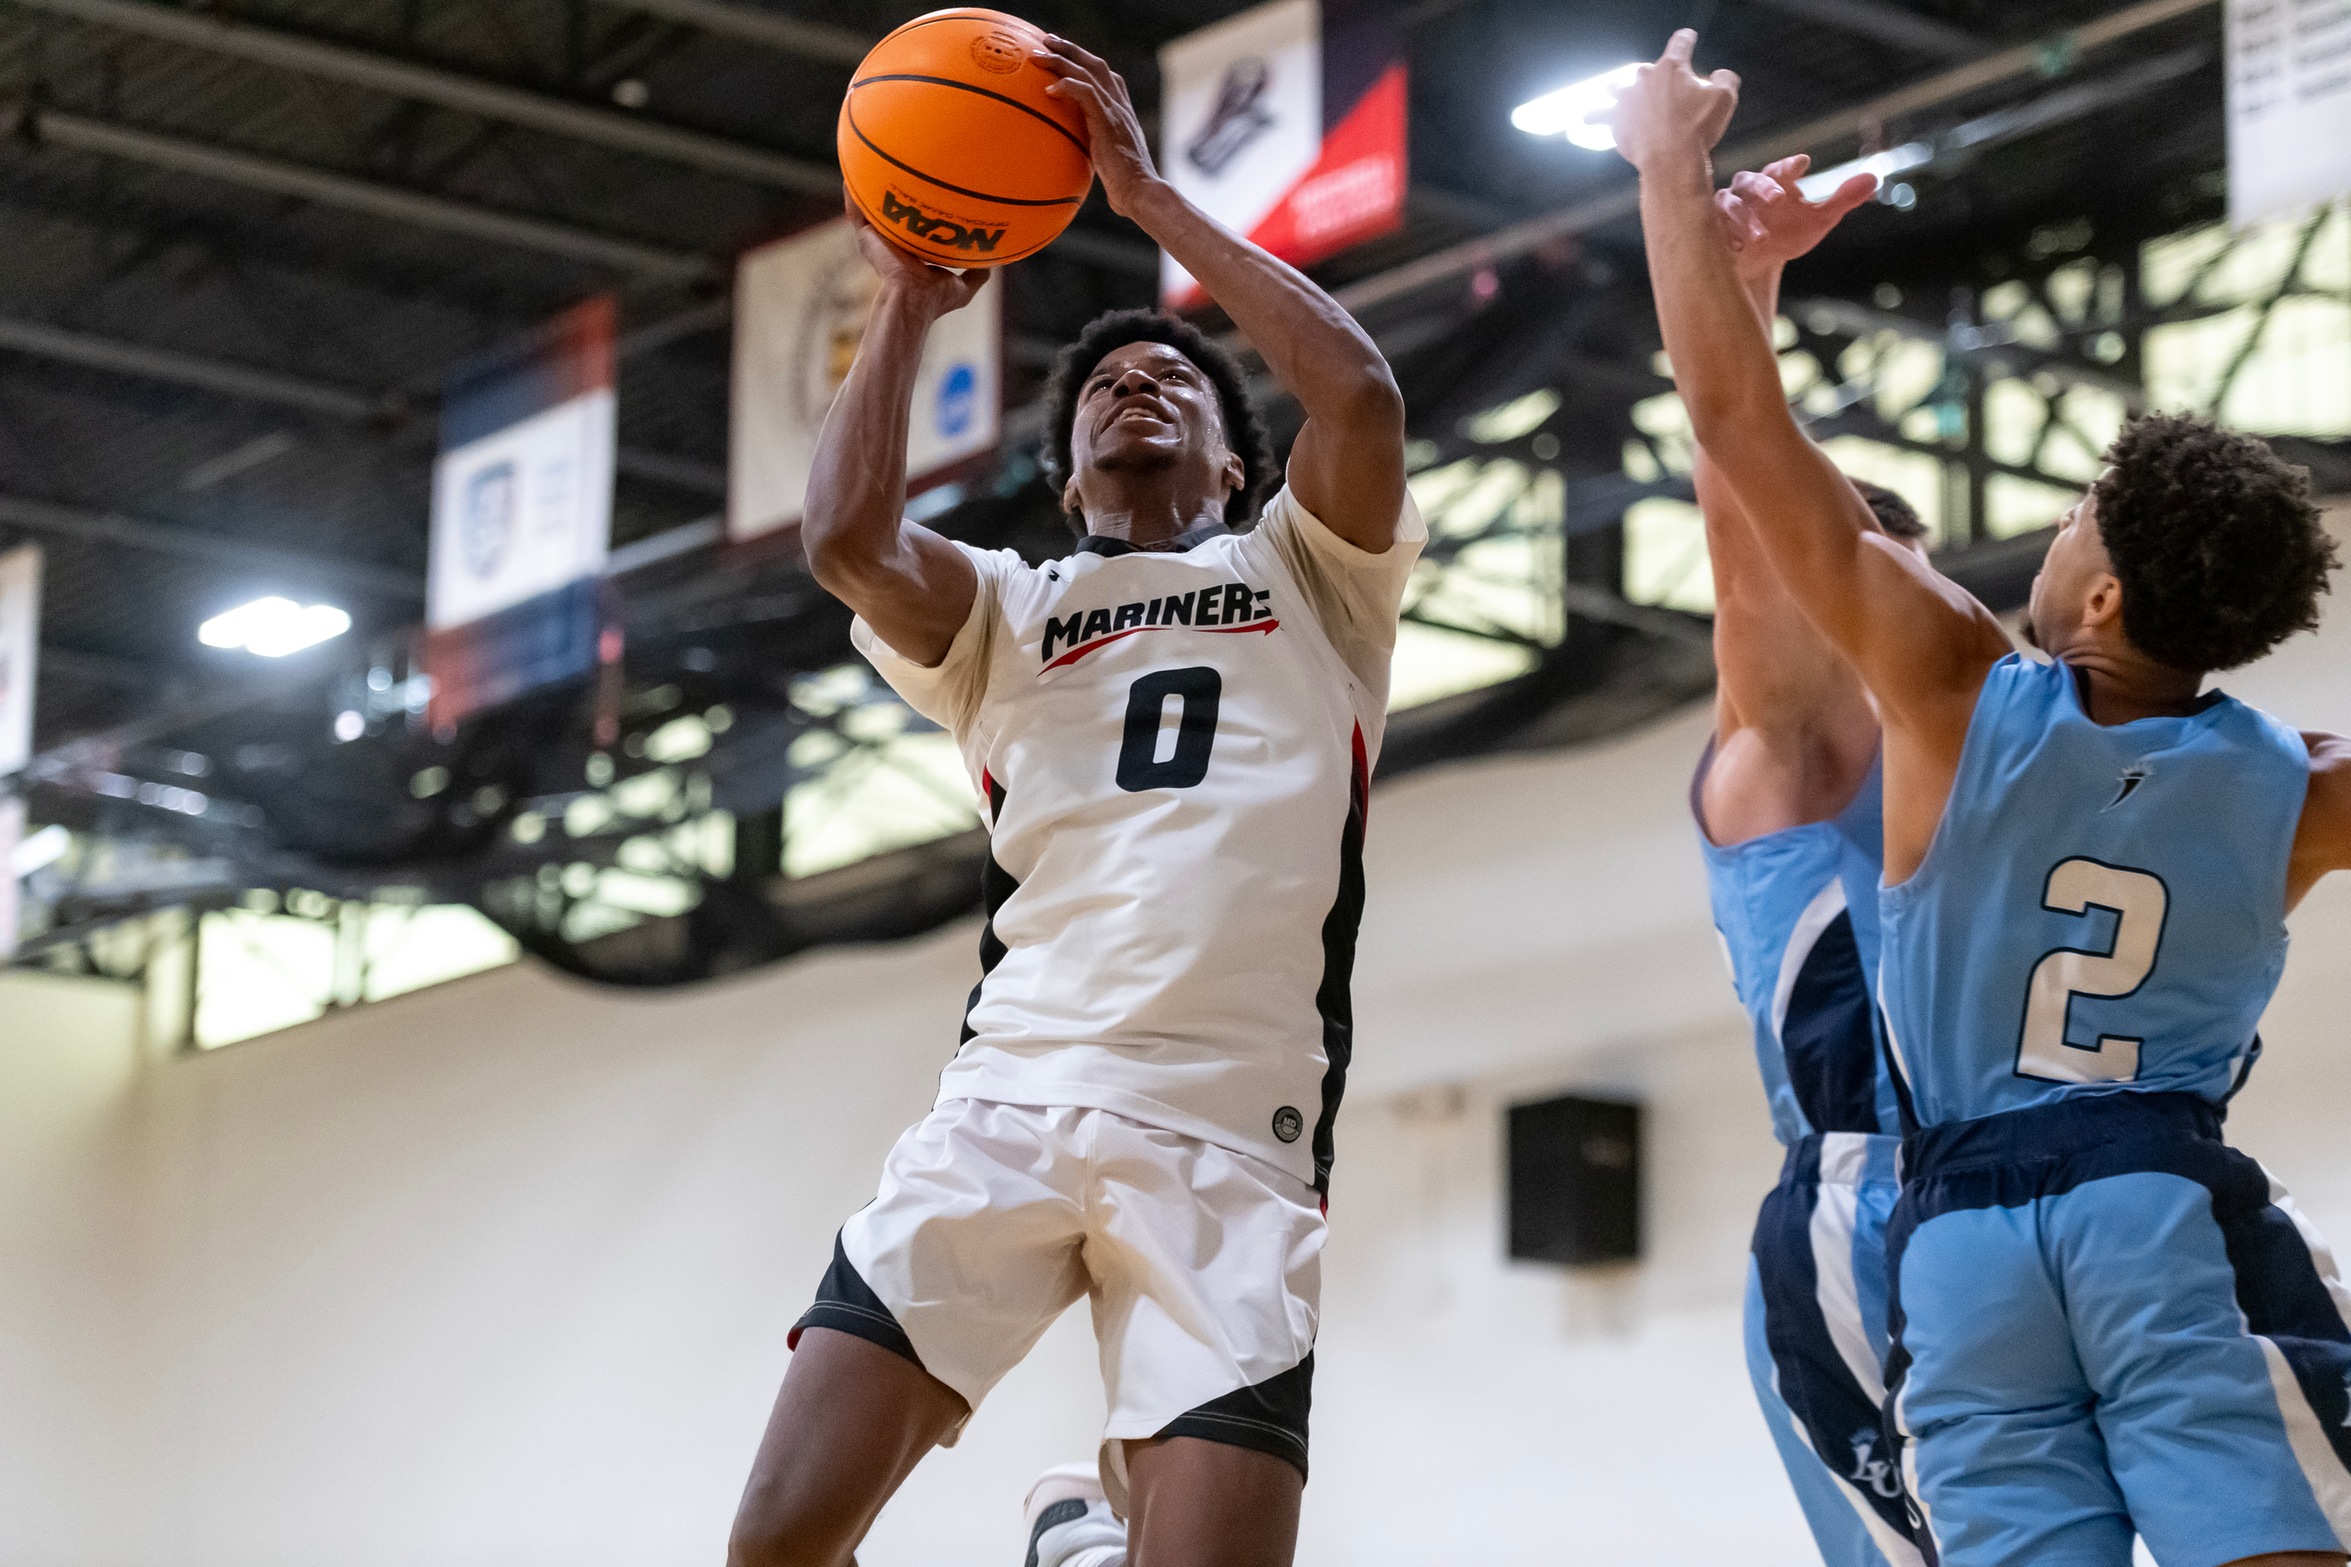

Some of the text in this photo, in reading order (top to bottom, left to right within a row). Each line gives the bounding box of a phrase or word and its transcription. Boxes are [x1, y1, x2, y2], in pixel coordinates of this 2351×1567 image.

[882, 190, 1006, 252] NCAA
[1115, 666, 1222, 792] 0
[2013, 855, 2169, 1084] 2
